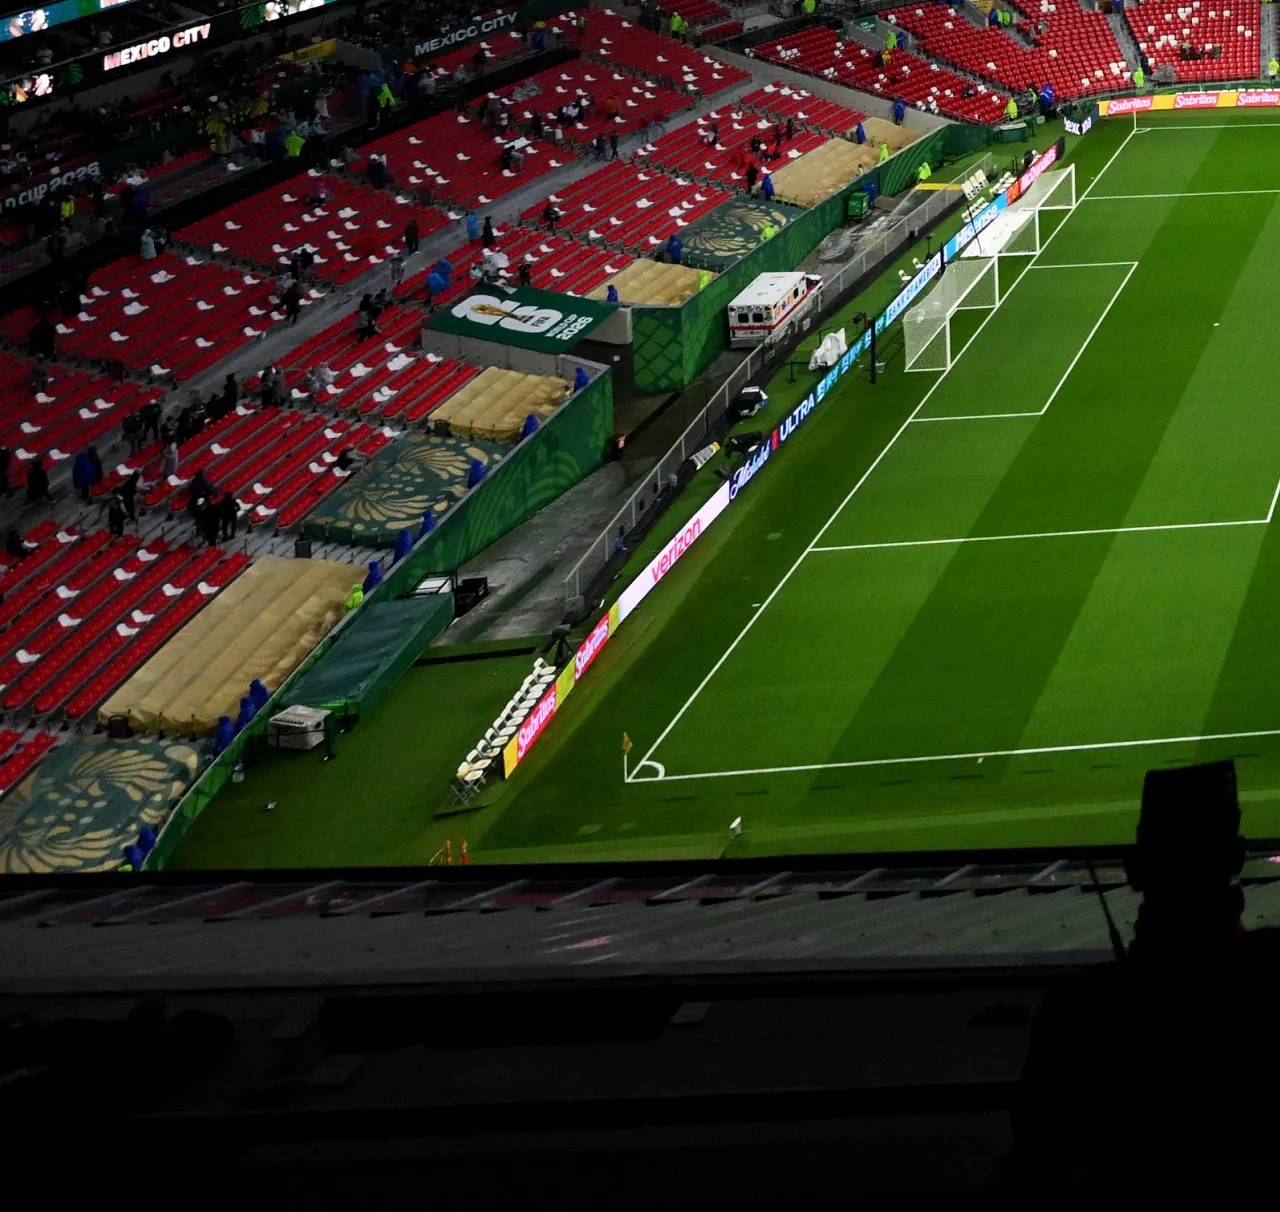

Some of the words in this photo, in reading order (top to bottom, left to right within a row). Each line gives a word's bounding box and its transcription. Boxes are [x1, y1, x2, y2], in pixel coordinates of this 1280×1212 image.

[481, 12, 518, 33] CITY
[104, 36, 170, 71] MEXICO
[172, 24, 211, 47] CITY
[1107, 97, 1153, 114] Sabritas
[1175, 93, 1219, 109] Sabritas
[1236, 91, 1280, 107] Sabritas
[18, 183, 48, 206] CUP
[955, 203, 1000, 249] Hisense
[531, 316, 552, 328] FIFA
[556, 316, 594, 340] 2026
[730, 437, 771, 500] Michelob
[780, 394, 815, 441] ULTRA
[651, 518, 701, 582] verizon
[575, 620, 609, 679] Sabritas
[517, 690, 556, 758] Sabritas
